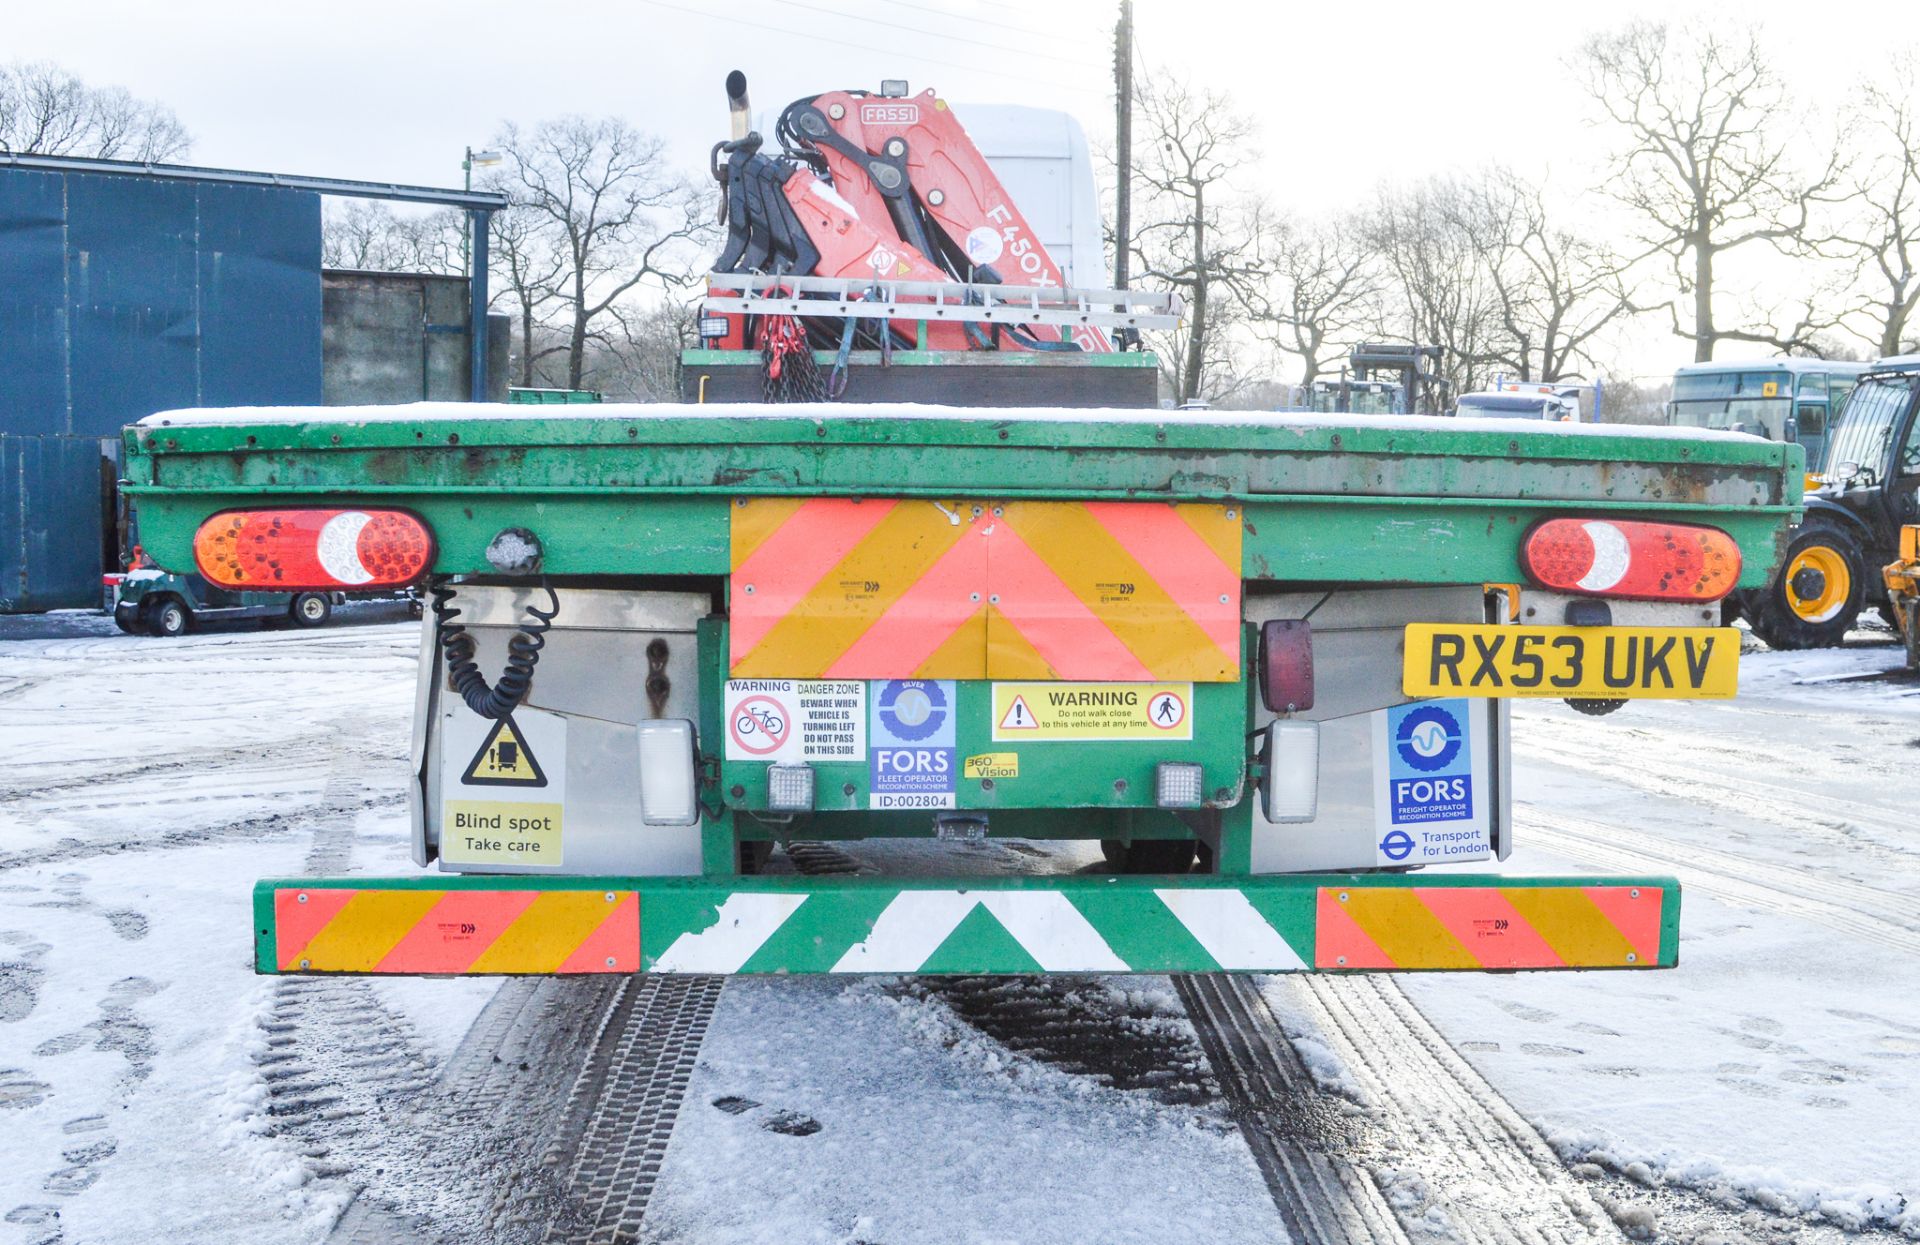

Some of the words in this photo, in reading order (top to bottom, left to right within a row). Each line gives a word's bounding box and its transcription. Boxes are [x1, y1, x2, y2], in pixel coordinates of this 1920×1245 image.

[866, 108, 913, 121] FASSI
[1429, 633, 1585, 688] RX53
[1602, 635, 1715, 689] UKV
[730, 681, 791, 692] WARNING
[798, 684, 834, 695] DANGER
[835, 684, 860, 695] ZONE
[902, 680, 925, 690] SILVER
[800, 699, 833, 708] BEWARE
[834, 699, 858, 708] WHEN
[1049, 691, 1138, 707] WARNING
[808, 710, 841, 720] VEHICLE
[841, 710, 850, 720] IS
[1058, 709, 1069, 718] Do
[1072, 710, 1086, 718] not
[1088, 709, 1107, 718] walk
[1109, 709, 1132, 718] close
[803, 722, 838, 732] TURNING
[839, 722, 856, 732] LEFT
[1042, 721, 1051, 729] to
[1052, 720, 1069, 729] this
[1070, 720, 1100, 729] vehicle
[1102, 720, 1110, 728] at
[1112, 722, 1127, 730] any
[1129, 720, 1148, 728] time
[804, 734, 816, 743] DO
[817, 734, 833, 743] NOT
[834, 734, 854, 743] PASS
[804, 745, 816, 755] ON
[817, 745, 836, 755] THIS
[837, 745, 854, 755] SIDE
[878, 750, 949, 773] FORS
[976, 766, 1016, 777] Vision
[878, 775, 903, 783] FLEET
[904, 775, 948, 783] OPERATOR
[1397, 778, 1466, 804] FORS
[879, 795, 948, 808] ID:002804
[1398, 806, 1428, 815] FREIGHT
[1429, 803, 1467, 812] OPERATOR
[1399, 812, 1441, 821] RECOGNITION
[455, 812, 501, 829] Blind
[508, 816, 552, 834] spot
[1422, 830, 1481, 843] Transport
[464, 837, 502, 852] Take
[507, 841, 541, 852] care
[1423, 845, 1441, 856] for
[1444, 843, 1489, 855] London
